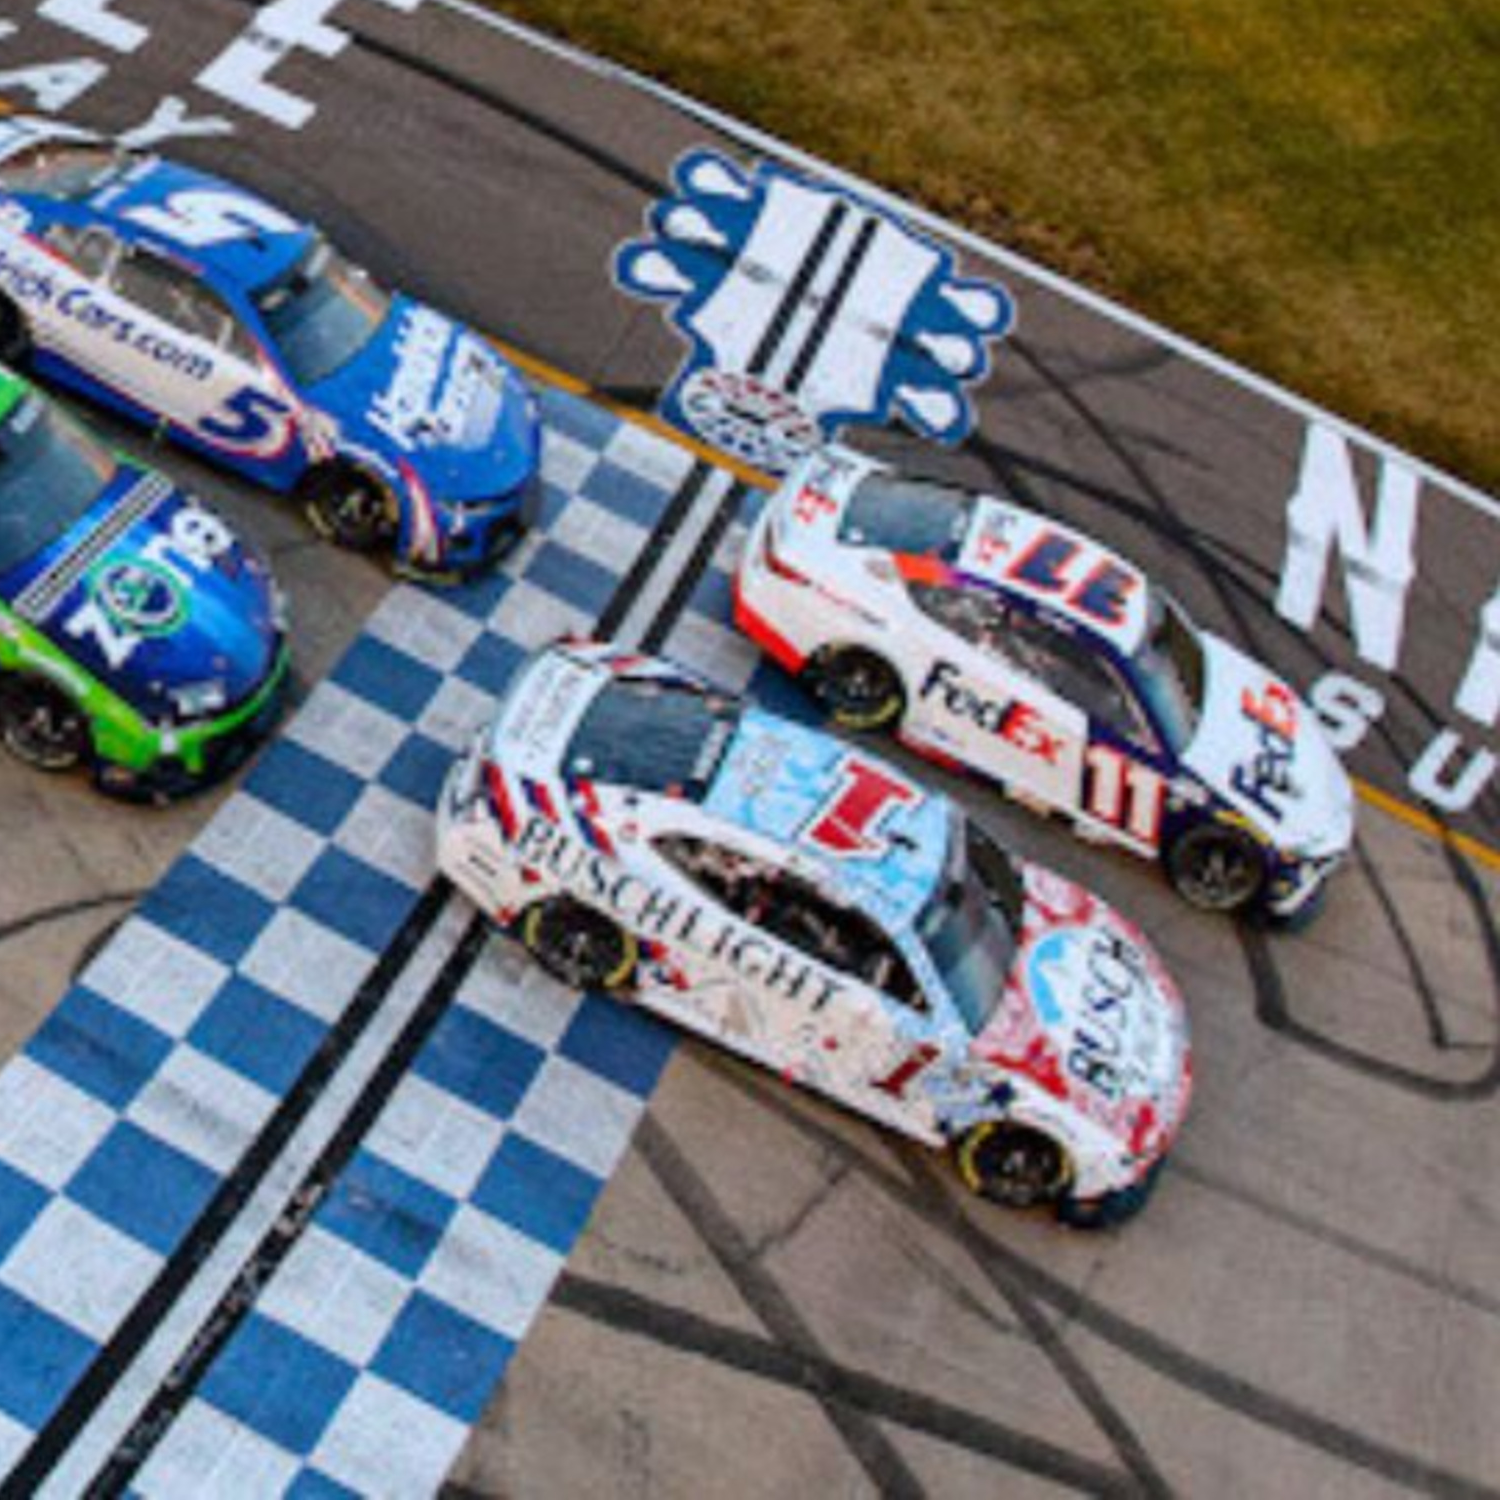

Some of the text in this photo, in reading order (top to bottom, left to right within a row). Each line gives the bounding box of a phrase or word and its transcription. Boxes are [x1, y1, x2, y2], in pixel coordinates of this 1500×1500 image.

[199, 385, 298, 445] 5
[917, 657, 1066, 765] FedEx
[808, 757, 926, 860] 1
[1084, 742, 1169, 846] 11
[870, 1042, 941, 1100] 1
